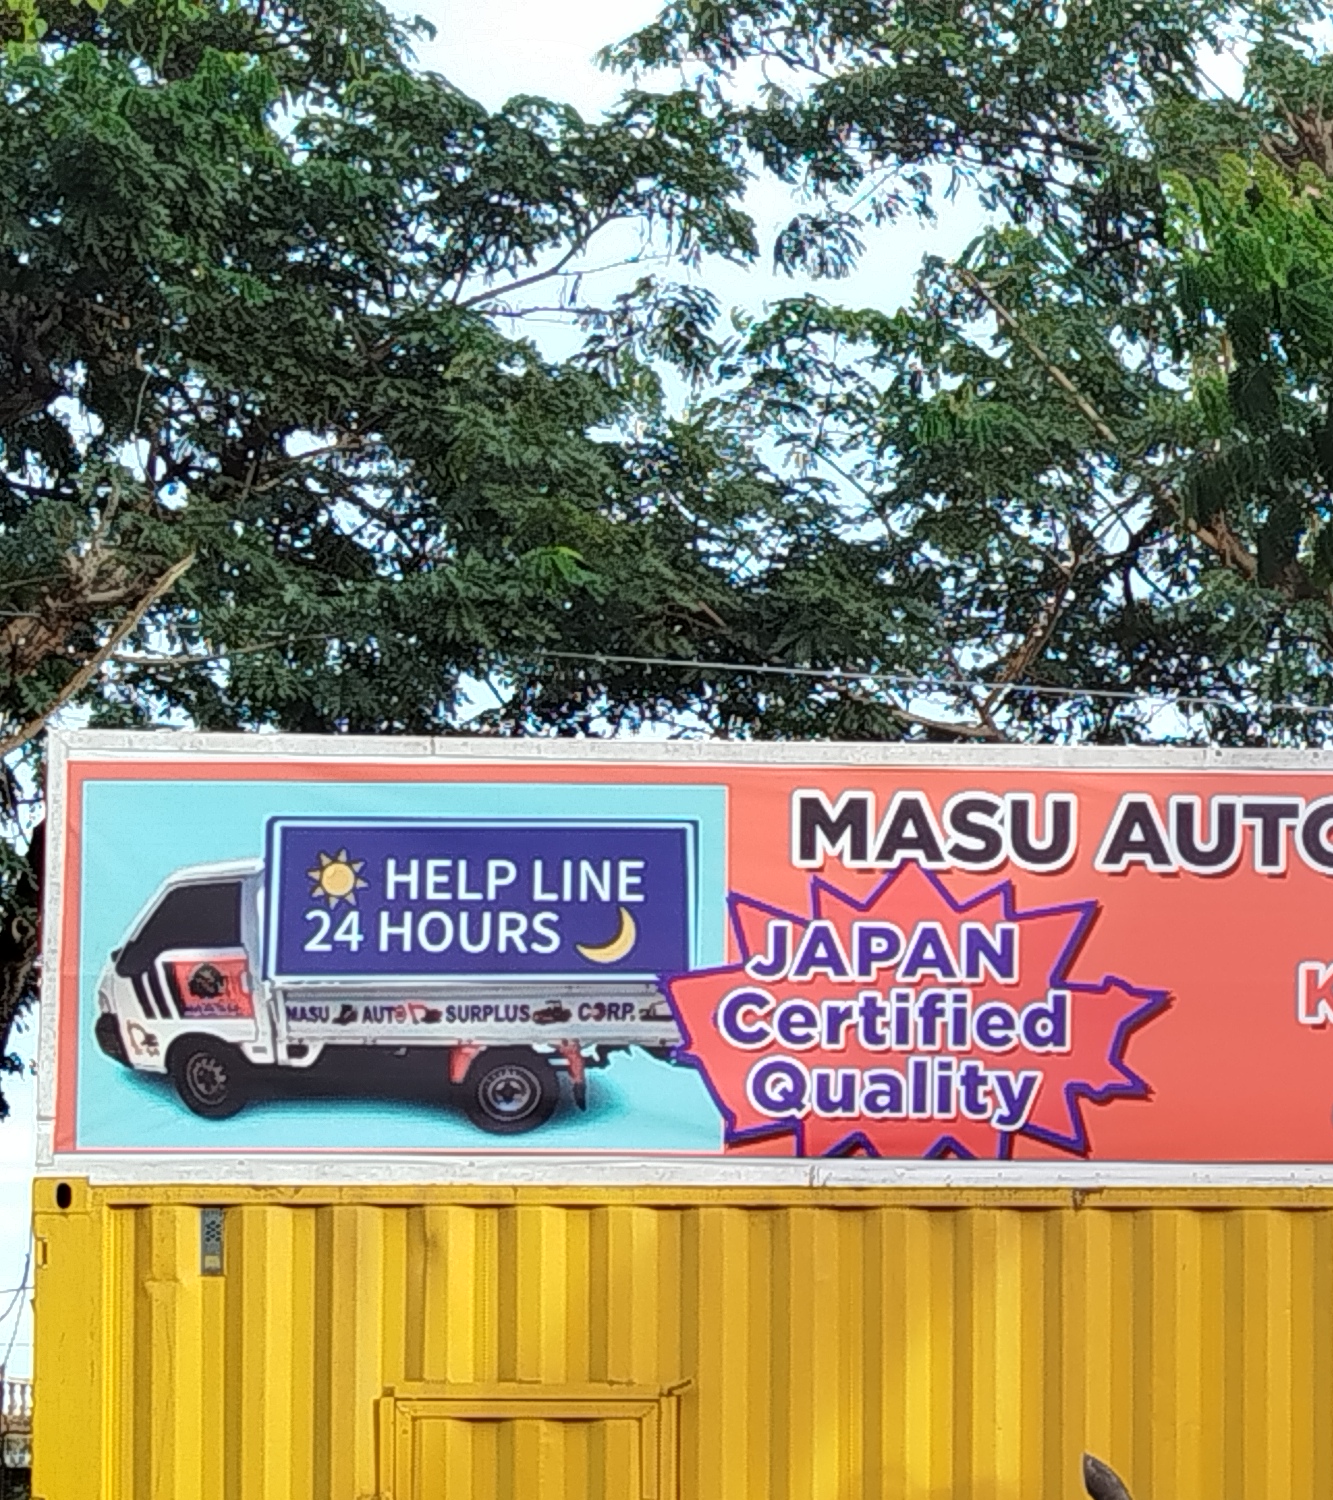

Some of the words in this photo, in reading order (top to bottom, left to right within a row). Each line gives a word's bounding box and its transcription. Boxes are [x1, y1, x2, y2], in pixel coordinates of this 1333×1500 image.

[797, 795, 1074, 868] MASU
[385, 858, 518, 901] HELP
[532, 858, 647, 903] LINE
[302, 908, 365, 953] 24
[377, 909, 562, 955] HOURS
[750, 924, 1018, 981] JAPAN
[285, 1005, 330, 1023] MASU
[445, 1004, 531, 1023] SURPLUS
[720, 988, 1068, 1050] Certified
[750, 1058, 1038, 1126] Quality
